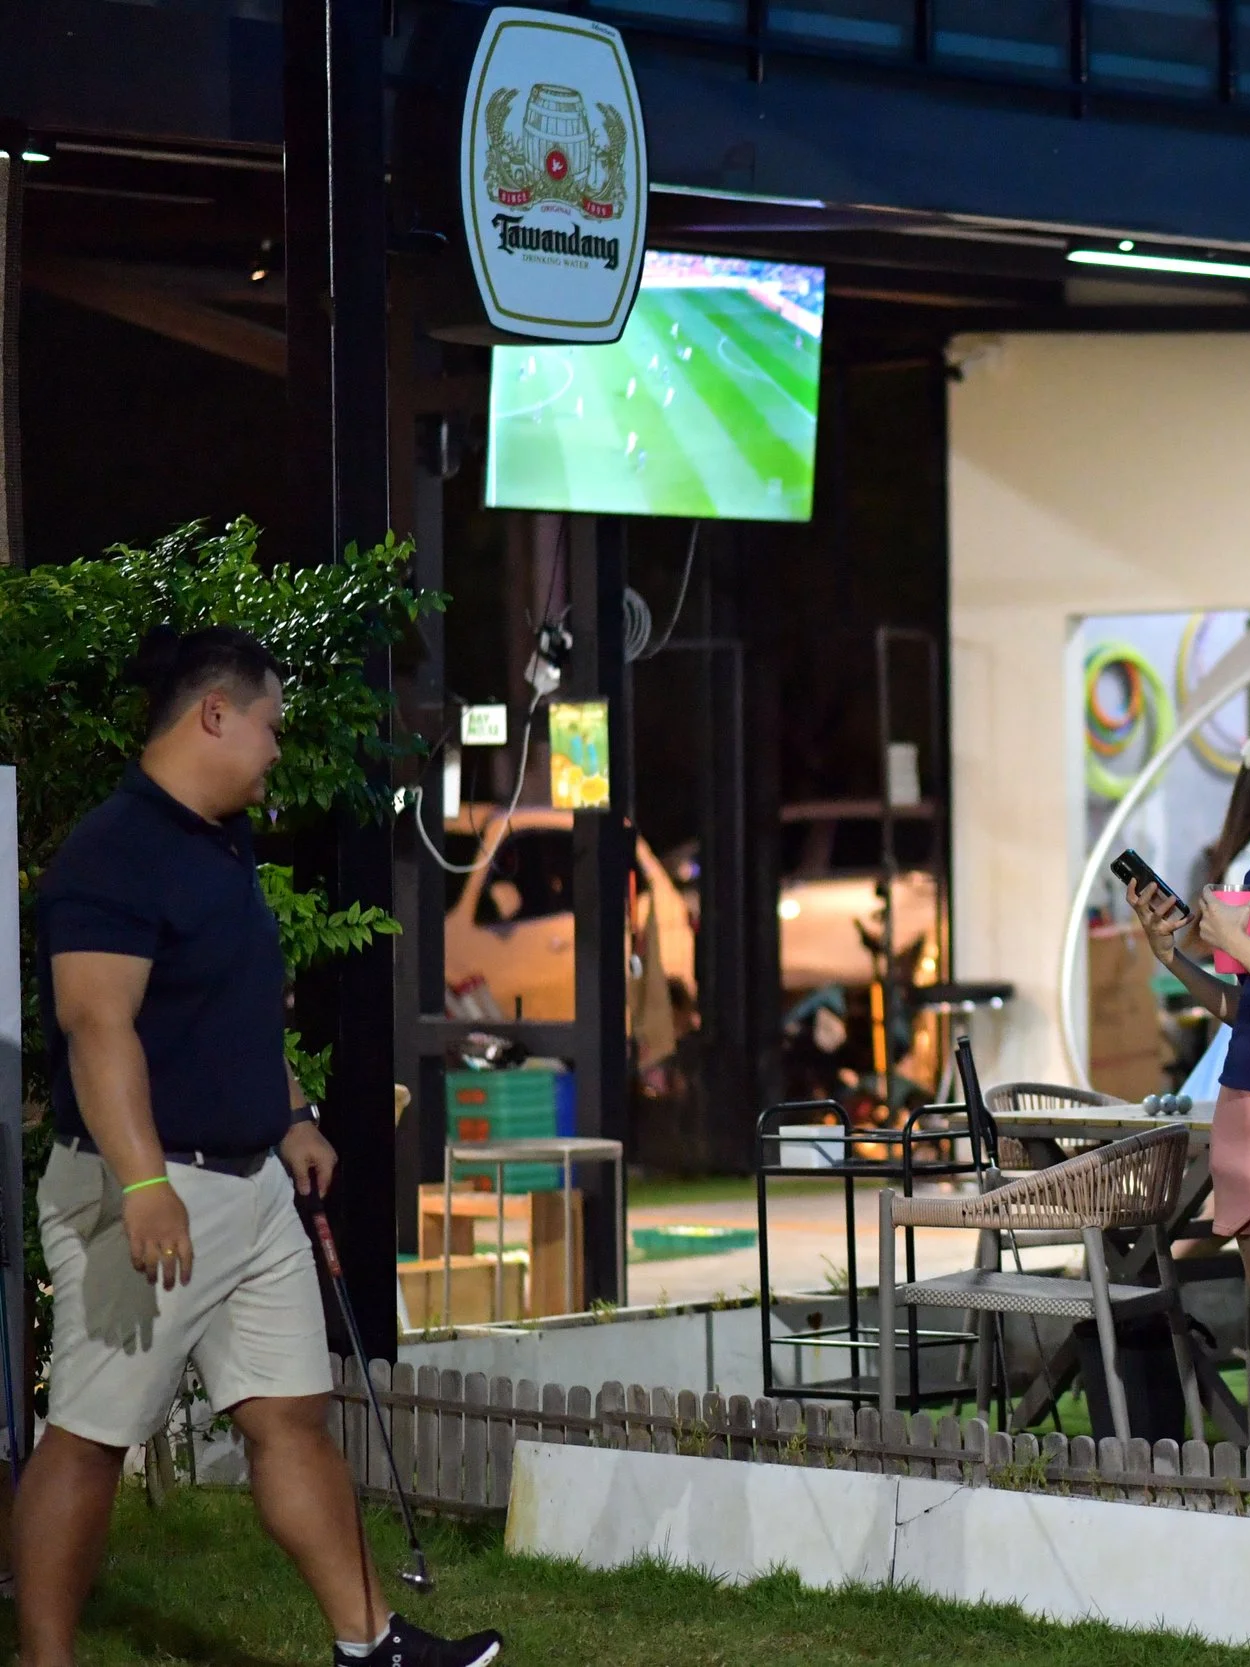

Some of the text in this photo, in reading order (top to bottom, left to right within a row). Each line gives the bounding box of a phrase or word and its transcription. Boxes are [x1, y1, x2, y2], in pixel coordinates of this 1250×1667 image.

[540, 204, 572, 216] ORIGINAL
[491, 213, 620, 271] Tawandang
[521, 253, 590, 270] DRINKING WATER
